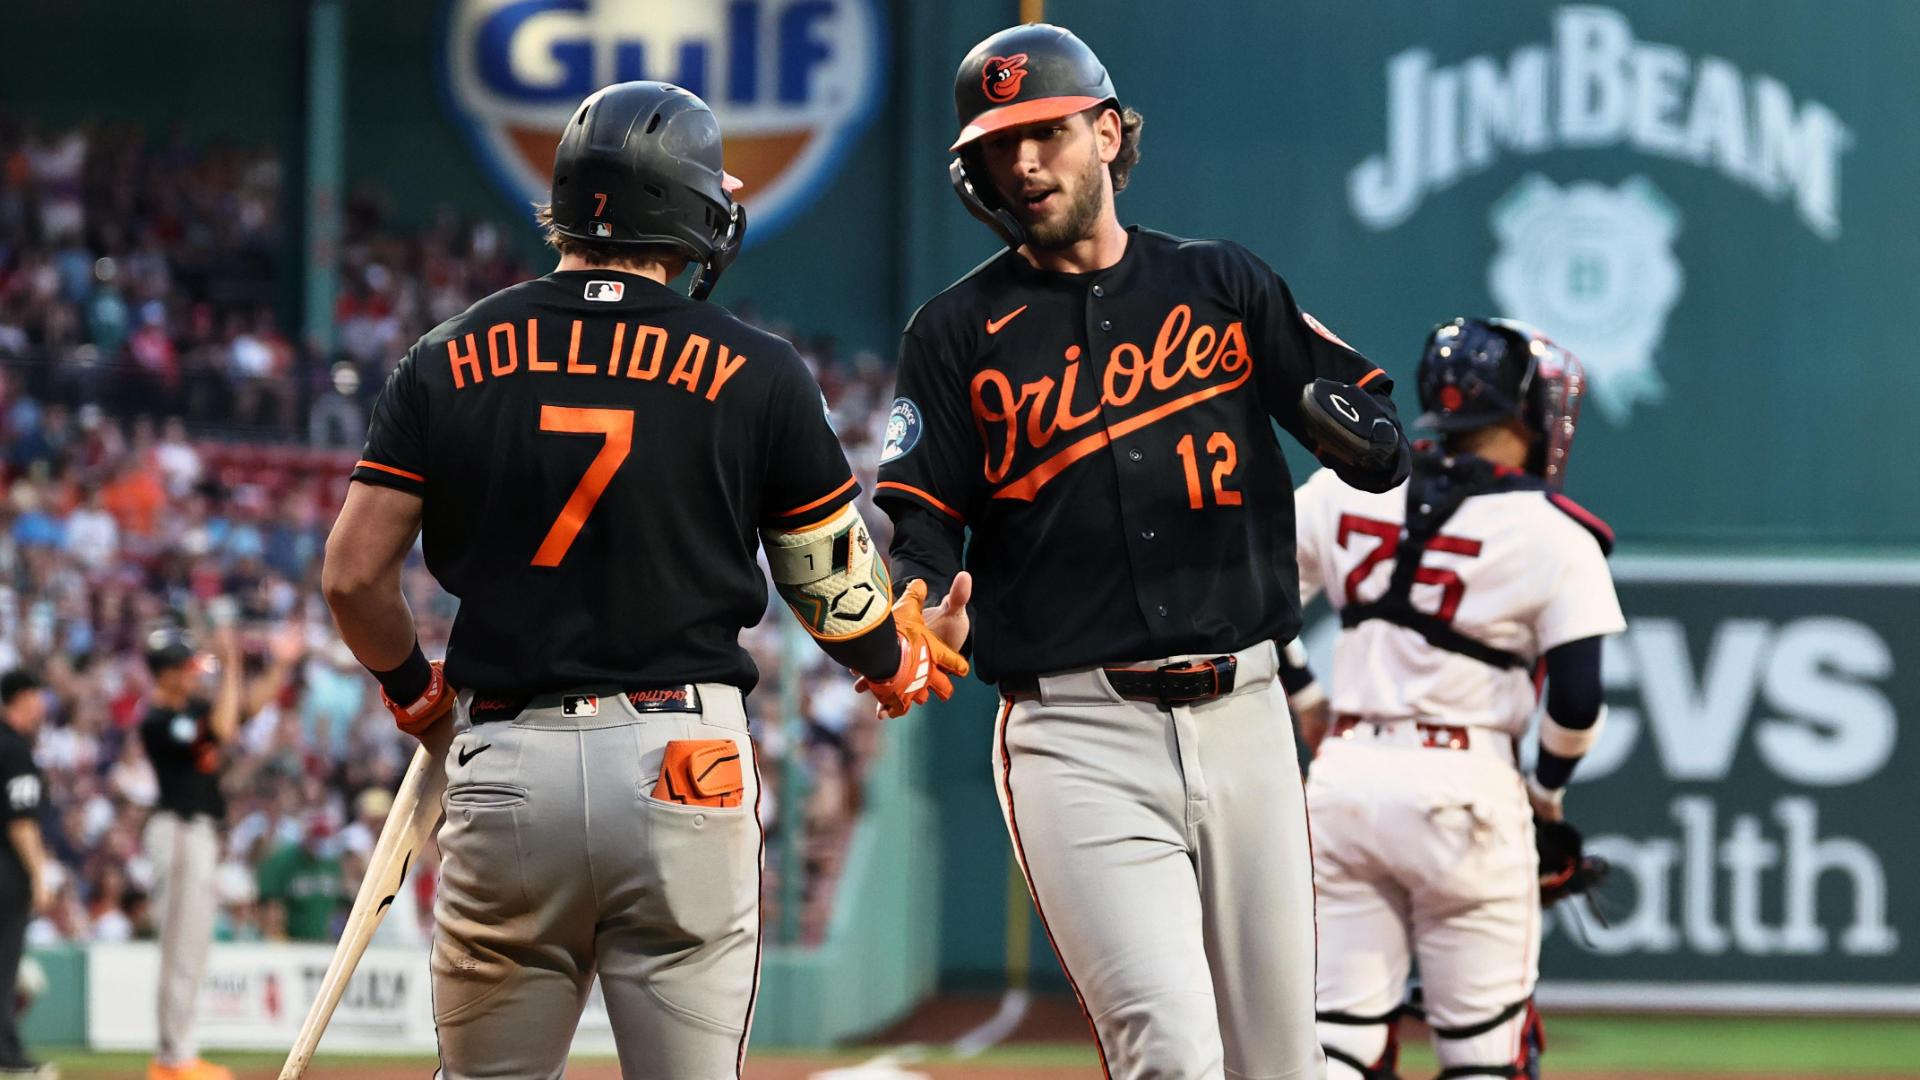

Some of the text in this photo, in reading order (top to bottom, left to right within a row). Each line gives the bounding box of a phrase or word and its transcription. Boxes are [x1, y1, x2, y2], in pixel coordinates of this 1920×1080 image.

[477, 0, 838, 107] Gulf
[1347, 3, 1850, 242] JIM BEAM
[594, 193, 607, 217] 7
[447, 318, 747, 402] HOLLIDAY
[969, 303, 1254, 485] Orioles
[530, 404, 635, 568] 7
[1176, 431, 1242, 510] 12
[1336, 512, 1483, 624] 75
[1543, 796, 1897, 955] alth
